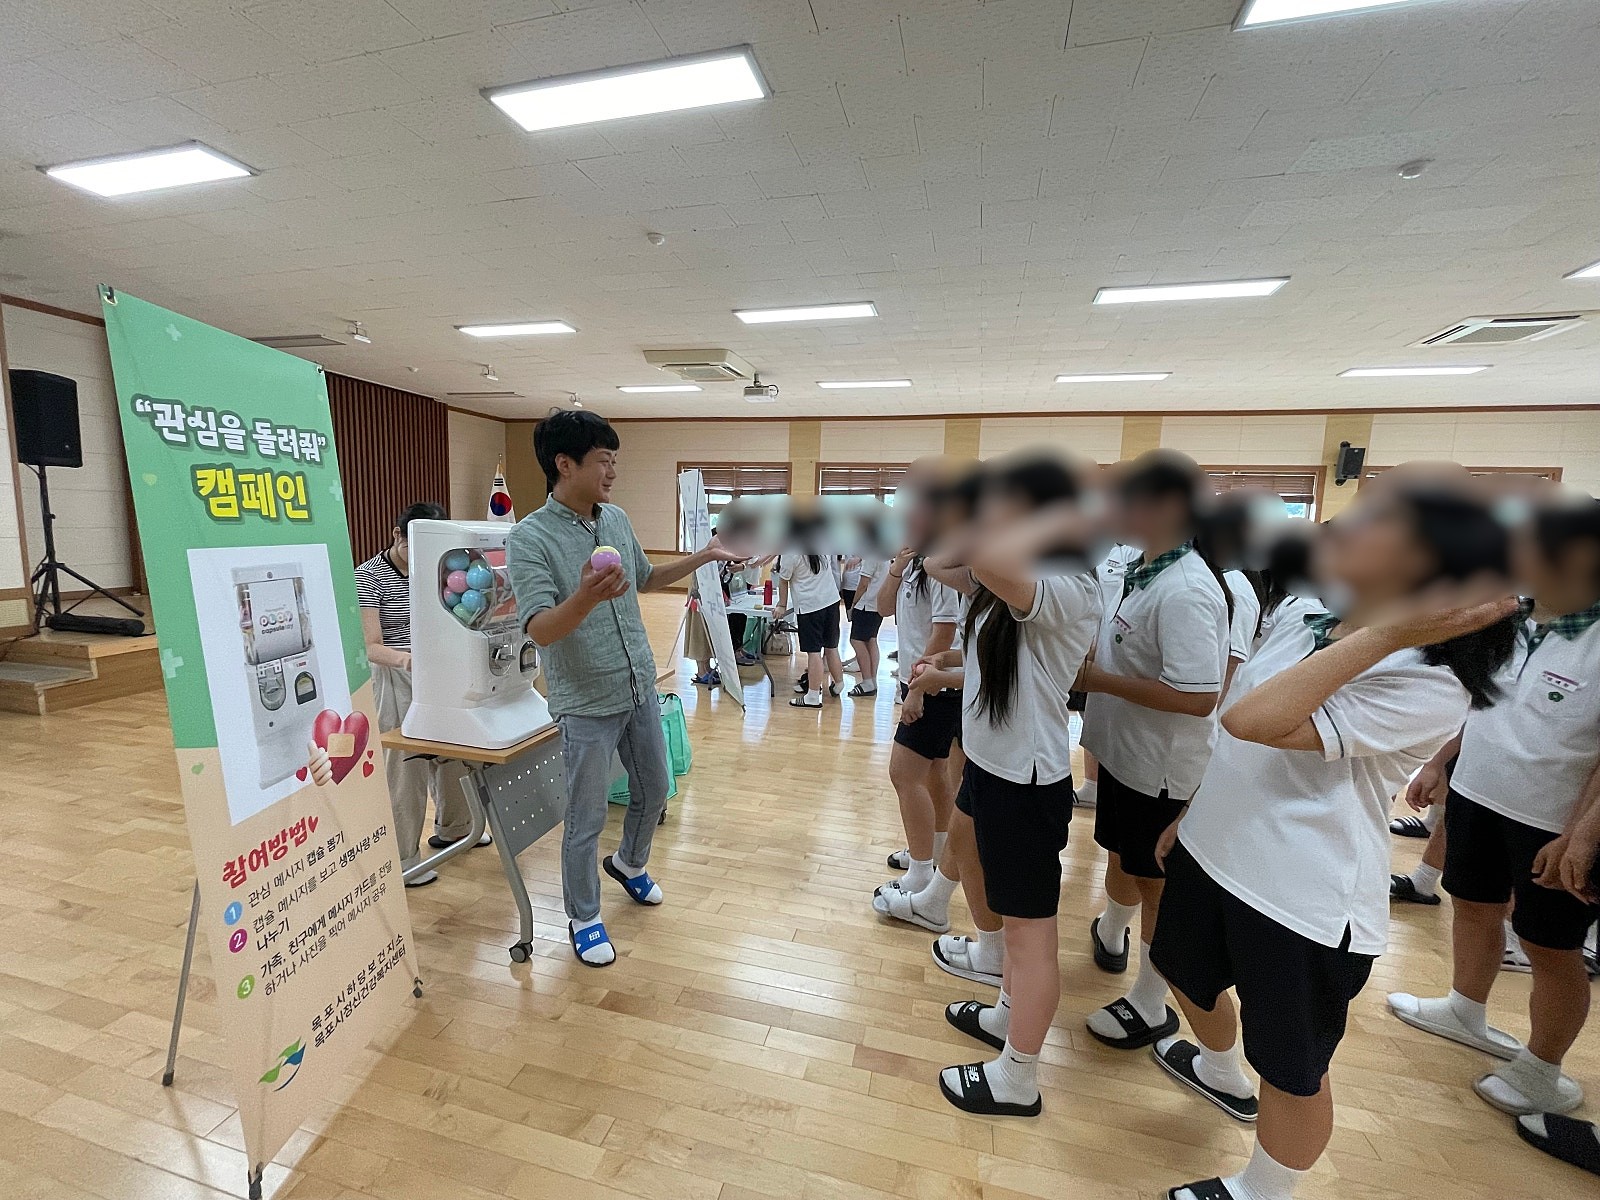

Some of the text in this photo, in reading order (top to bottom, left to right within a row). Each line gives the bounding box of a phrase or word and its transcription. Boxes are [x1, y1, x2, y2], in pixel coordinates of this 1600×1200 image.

[195, 467, 309, 519] 캠페인
[222, 816, 308, 889] 참여방법
[248, 881, 271, 908] 관심
[273, 858, 305, 888] 메시지
[306, 846, 325, 867] 캡슐
[327, 830, 345, 853] 뽑기
[252, 909, 275, 934] 캡슐
[277, 876, 317, 913] 메시지를
[319, 861, 338, 884] 보고
[339, 835, 371, 868] 생명사랑
[372, 824, 387, 844] 생각
[256, 916, 290, 951] 나누기
[264, 882, 387, 996] 하거나 사진을 찍어 메시지 공유
[288, 914, 327, 955] 친구에게
[327, 892, 353, 920] 메시지
[354, 872, 377, 898] 카드를
[378, 859, 392, 879] 전달
[314, 943, 406, 1048] 목포시정신건강복지센터
